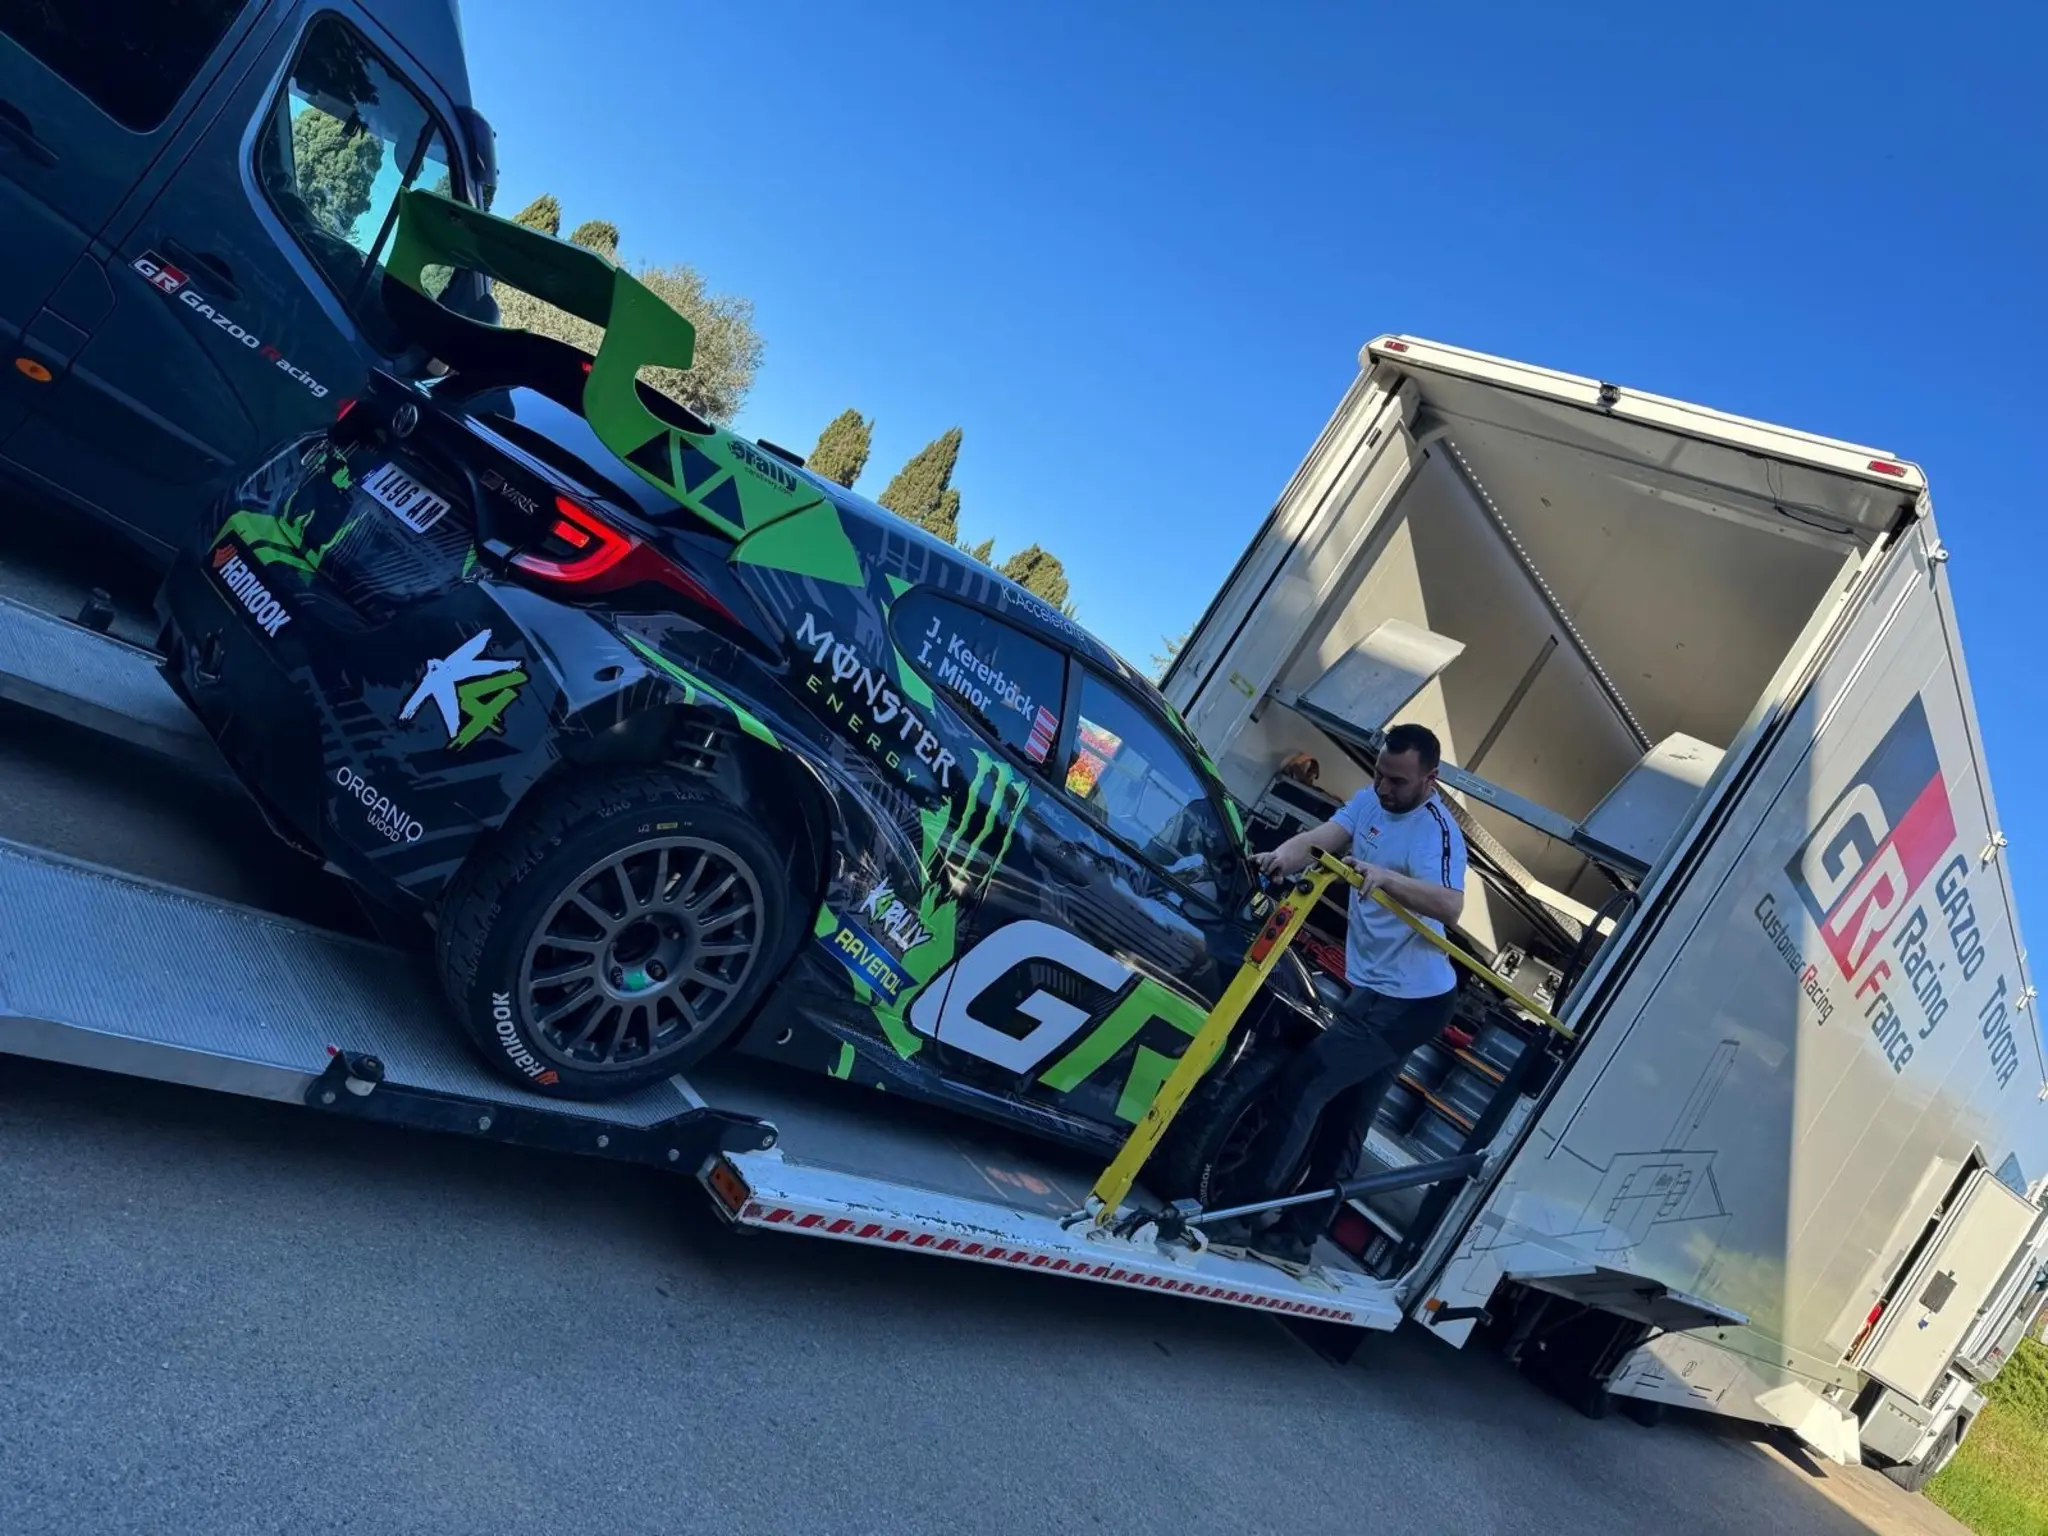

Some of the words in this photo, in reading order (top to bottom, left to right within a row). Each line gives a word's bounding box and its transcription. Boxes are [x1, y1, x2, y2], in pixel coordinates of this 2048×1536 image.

[134, 258, 180, 292] GR
[179, 290, 260, 349] GAZOO
[260, 343, 329, 398] Racing
[373, 470, 420, 509] 1496
[405, 495, 445, 528] AM
[918, 641, 933, 668] I.
[938, 660, 992, 712] Minor
[926, 616, 942, 645] J.
[399, 628, 528, 751] K4
[806, 674, 917, 784] ENERGY
[336, 766, 424, 843] ORGANIQ
[367, 811, 401, 843] WOOD
[1801, 783, 1909, 970] GR
[1935, 853, 1986, 983] GAZOO
[1753, 892, 1806, 977] Customer
[1800, 963, 1834, 1026] Racing
[1855, 959, 1915, 1074] France
[1893, 905, 1949, 1040] Racing
[1979, 974, 2019, 1091] TOYOTA
